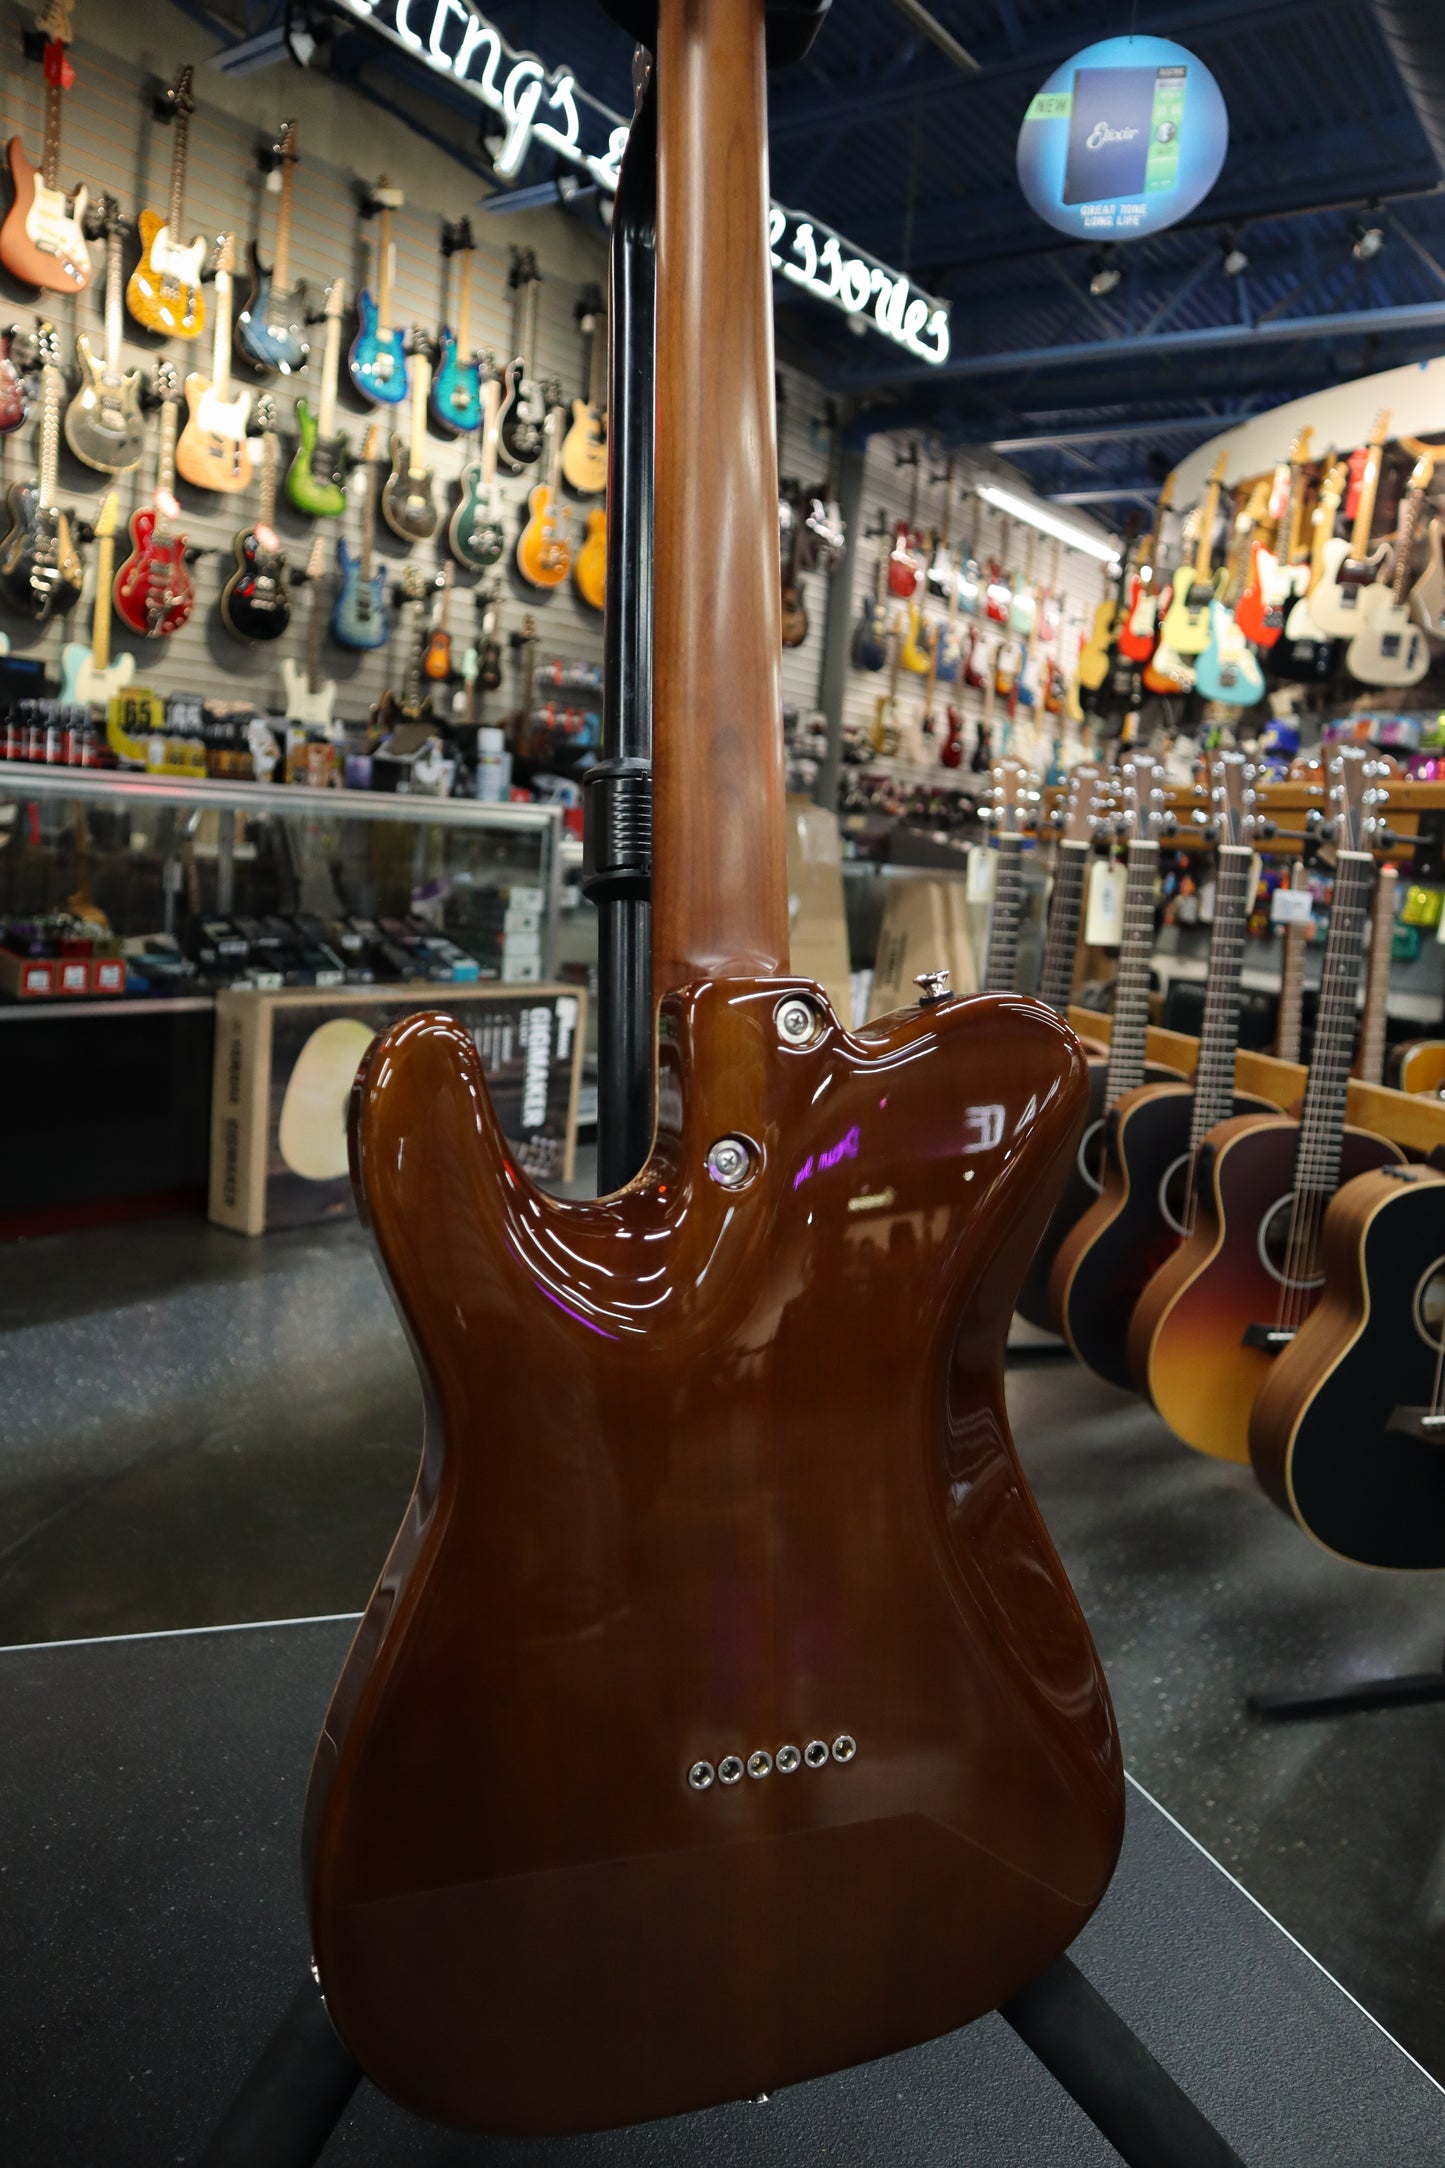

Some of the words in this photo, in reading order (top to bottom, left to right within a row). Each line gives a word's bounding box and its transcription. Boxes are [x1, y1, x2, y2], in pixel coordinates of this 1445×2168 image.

[1034, 98, 1067, 113] NEW
[1086, 121, 1140, 149] Elixir
[1080, 204, 1115, 217] GREAT
[1120, 203, 1147, 215] TONE
[1084, 215, 1114, 227] LONG
[1116, 214, 1140, 226] LIFE
[522, 1006, 552, 1128] GIGMAKER
